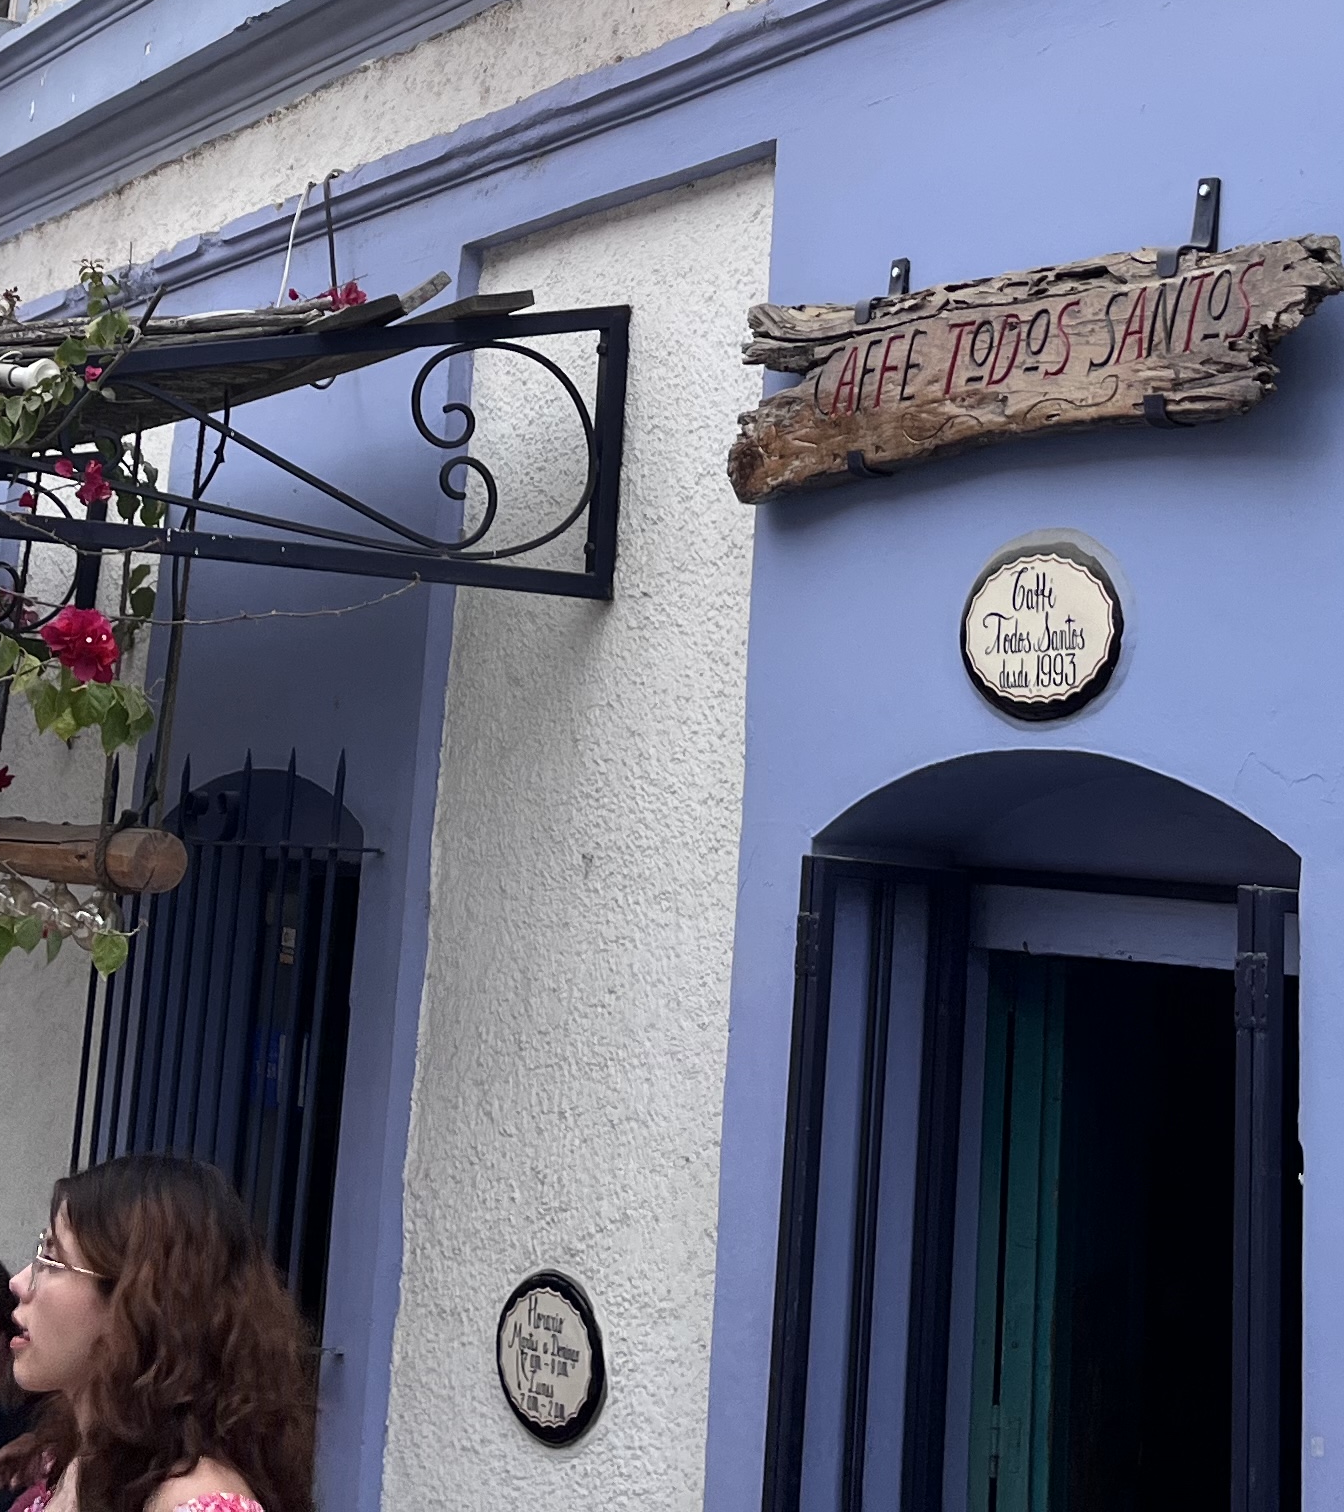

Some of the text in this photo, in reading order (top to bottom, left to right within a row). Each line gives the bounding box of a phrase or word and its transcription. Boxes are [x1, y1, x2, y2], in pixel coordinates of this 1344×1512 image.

[813, 258, 1267, 417] CAFFE TODOS SANTOS
[982, 610, 1086, 656] Todos Santos
[1033, 652, 1077, 687] 1993
